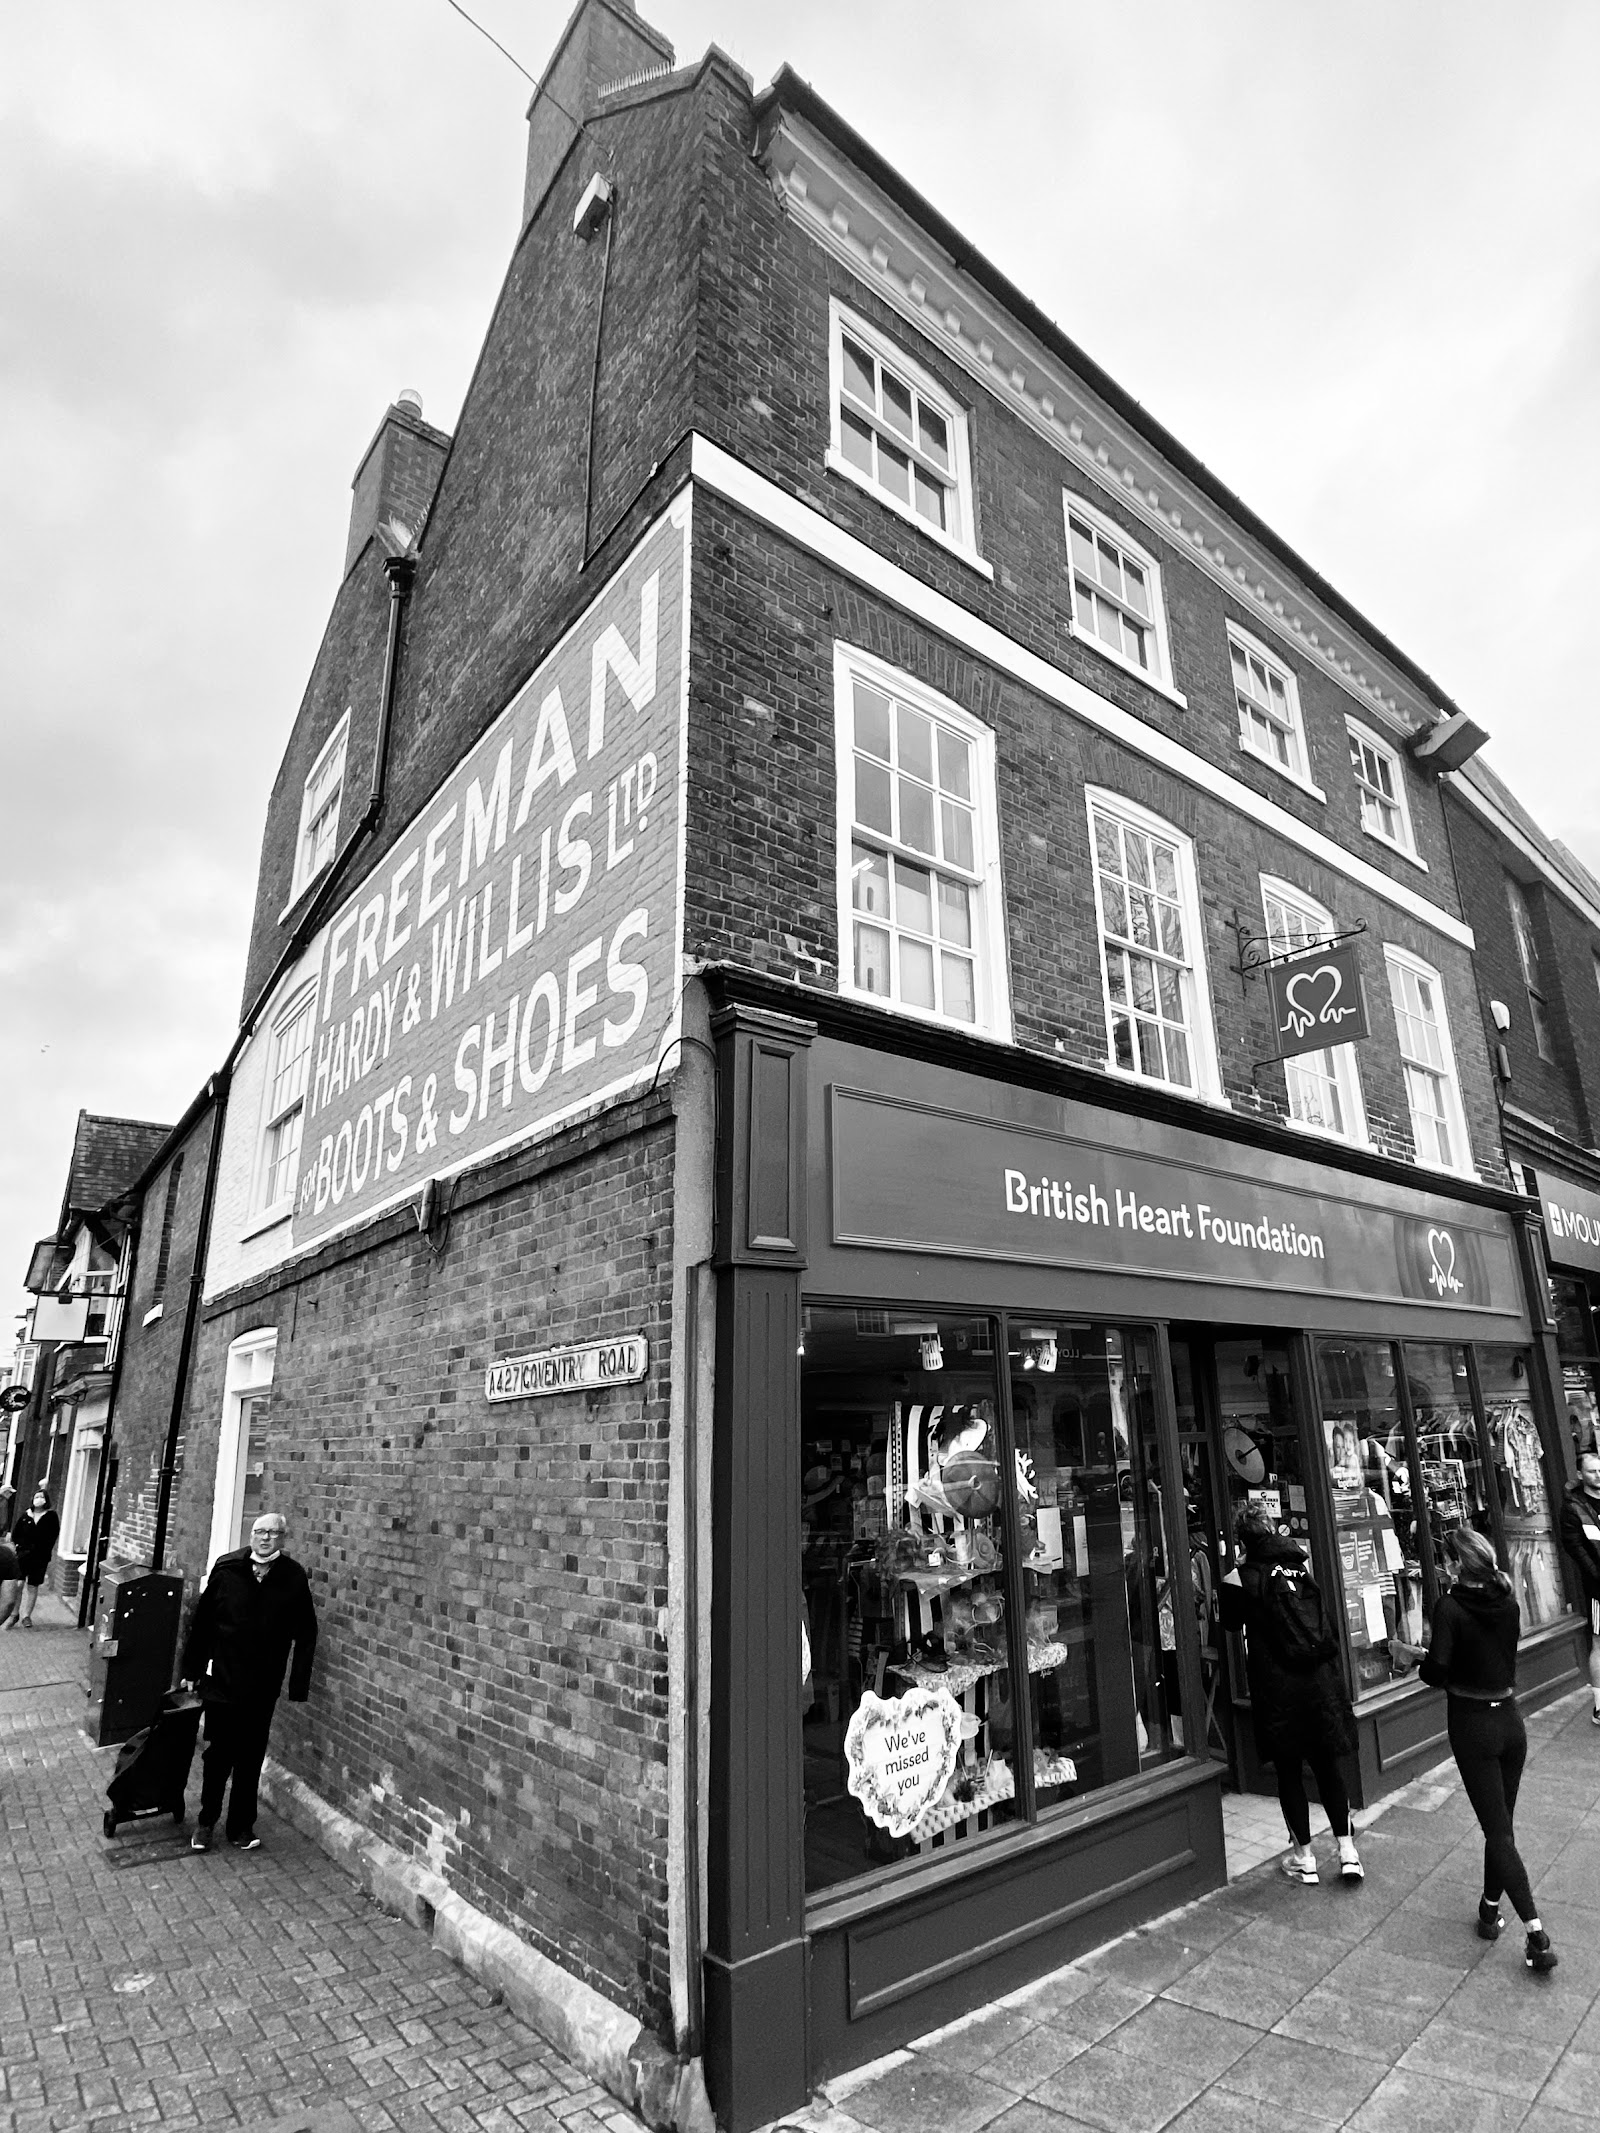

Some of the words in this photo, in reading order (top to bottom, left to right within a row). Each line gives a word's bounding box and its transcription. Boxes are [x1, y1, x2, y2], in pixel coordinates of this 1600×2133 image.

[322, 568, 660, 1024] FREEMAN
[311, 965, 405, 1118] HARDY
[402, 962, 422, 1035] &
[430, 791, 593, 1020] WILLIS
[313, 1075, 413, 1216] BOOTS
[416, 1072, 438, 1155] &
[449, 907, 649, 1135] SHOES
[1004, 1168, 1110, 1226] British
[1115, 1188, 1194, 1239] Heart
[1197, 1203, 1325, 1259] Foundation
[1561, 1207, 1600, 1246] MOU
[489, 1366, 520, 1397] A427
[522, 1354, 586, 1390] COVENTRY
[599, 1345, 639, 1378] ROAD
[884, 1730, 926, 1753] We've
[885, 1746, 929, 1775] missed
[897, 1774, 920, 1796] you
